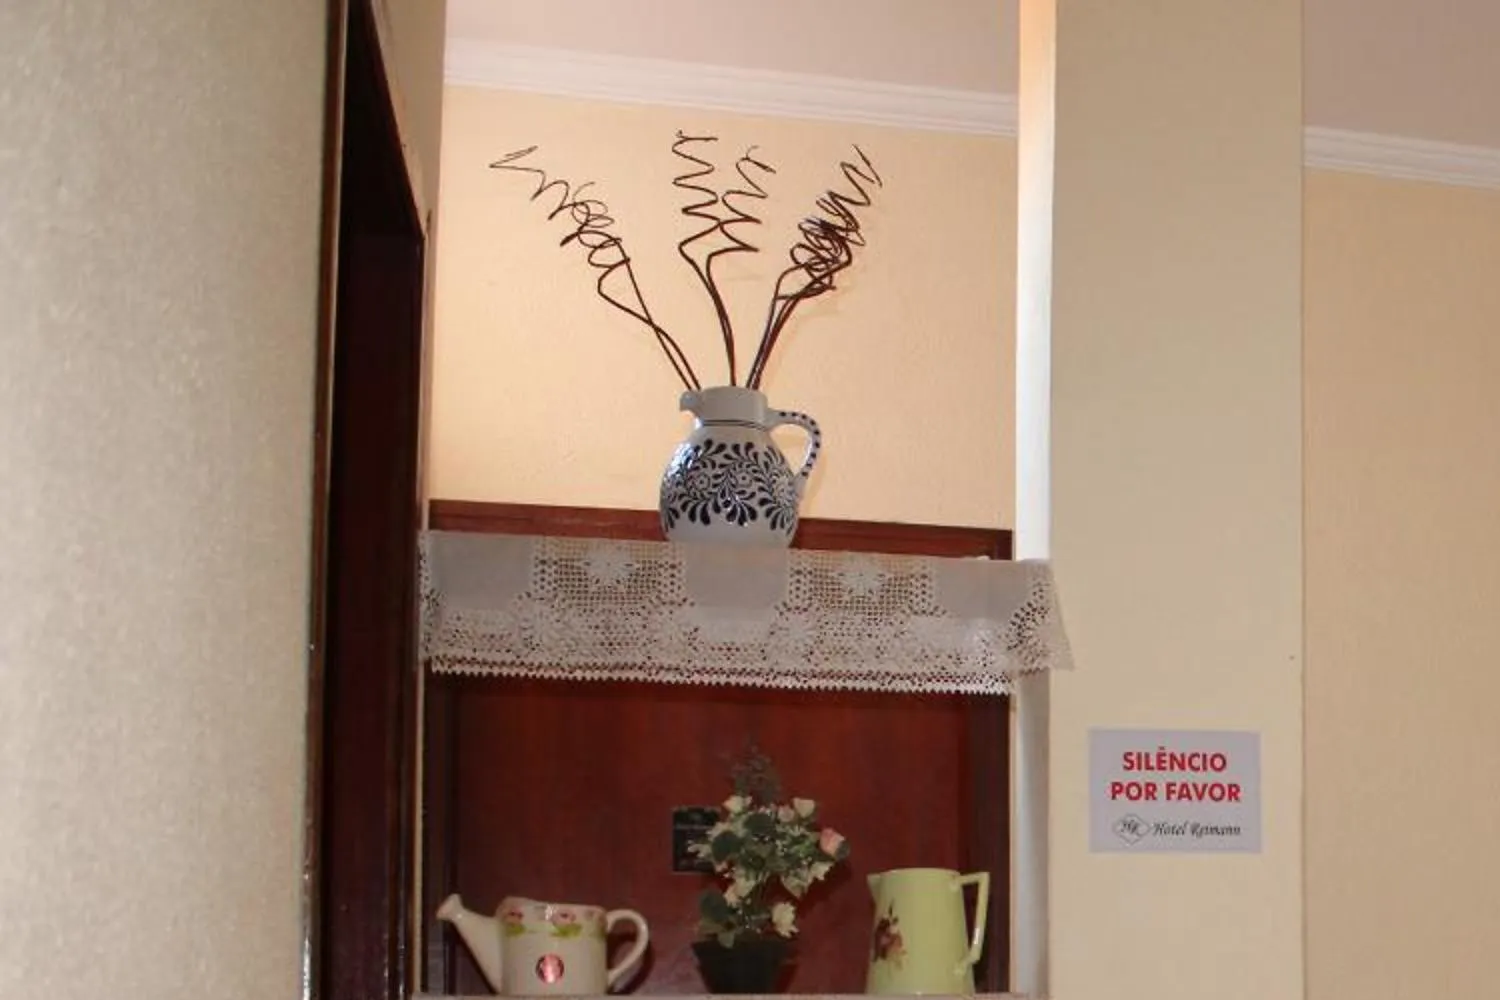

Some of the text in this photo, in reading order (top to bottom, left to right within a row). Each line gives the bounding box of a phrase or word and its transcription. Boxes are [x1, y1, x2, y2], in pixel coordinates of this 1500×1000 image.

[1122, 746, 1227, 772] SILÊNCIO
[1110, 781, 1241, 802] POR FAVOR
[1152, 820, 1188, 836] Hotel
